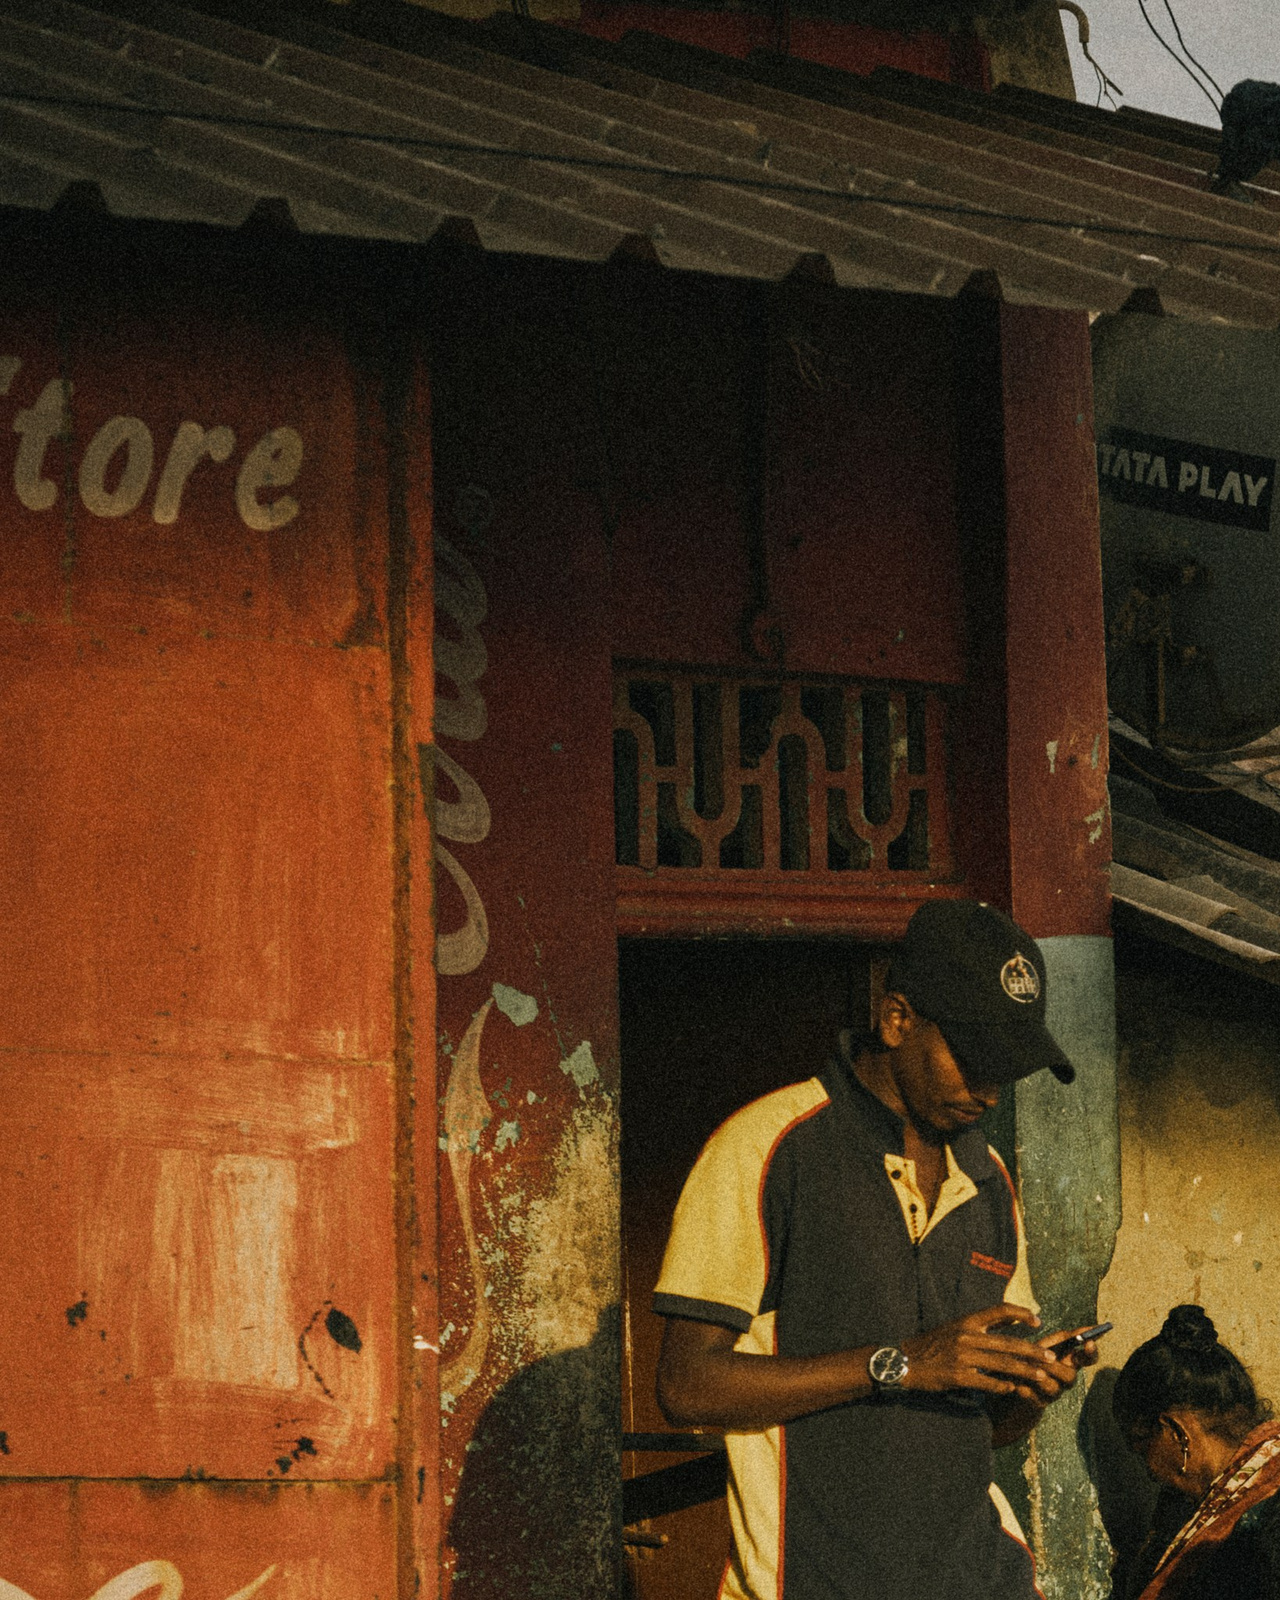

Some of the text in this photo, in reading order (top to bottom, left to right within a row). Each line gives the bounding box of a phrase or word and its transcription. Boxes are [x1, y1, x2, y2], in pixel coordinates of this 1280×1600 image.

[0, 355, 304, 532] tore
[1099, 443, 1269, 507] TATA PLAY
